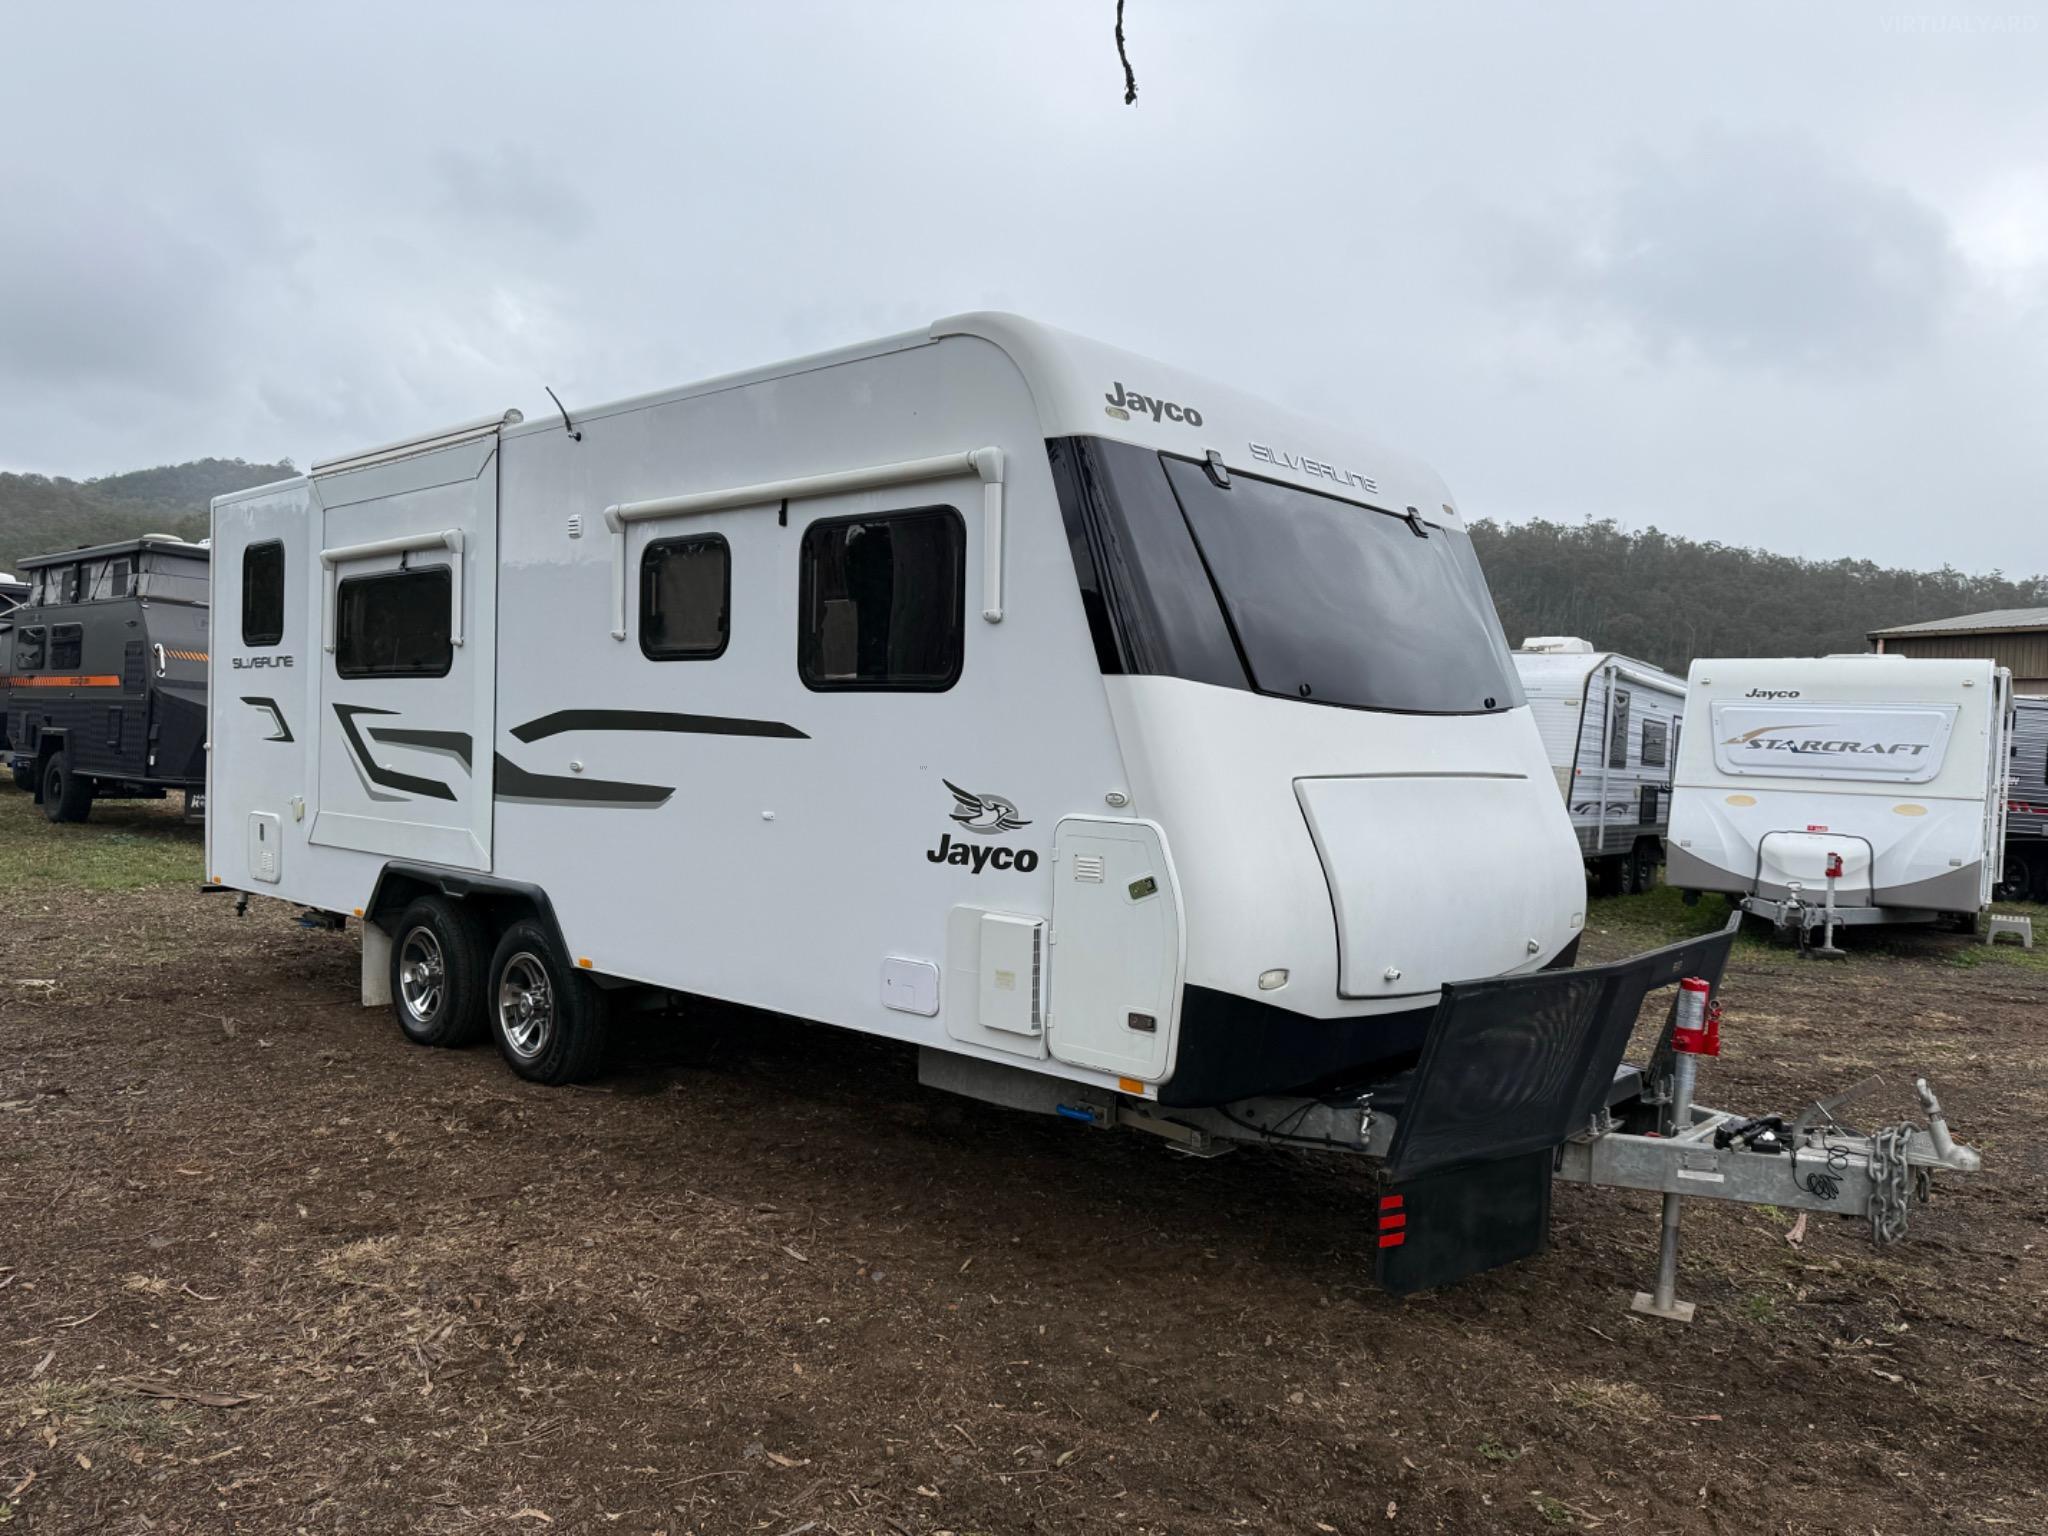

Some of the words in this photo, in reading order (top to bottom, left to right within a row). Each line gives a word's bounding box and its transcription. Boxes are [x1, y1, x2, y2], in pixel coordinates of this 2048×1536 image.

[1105, 381, 1203, 427] Jayco
[1249, 441, 1379, 493] SILVERLINE
[231, 655, 295, 670] SILVERLINE
[1745, 688, 1800, 700] Jayco
[1746, 738, 1930, 756] STARCRAFT
[926, 833, 1039, 875] Jayco
